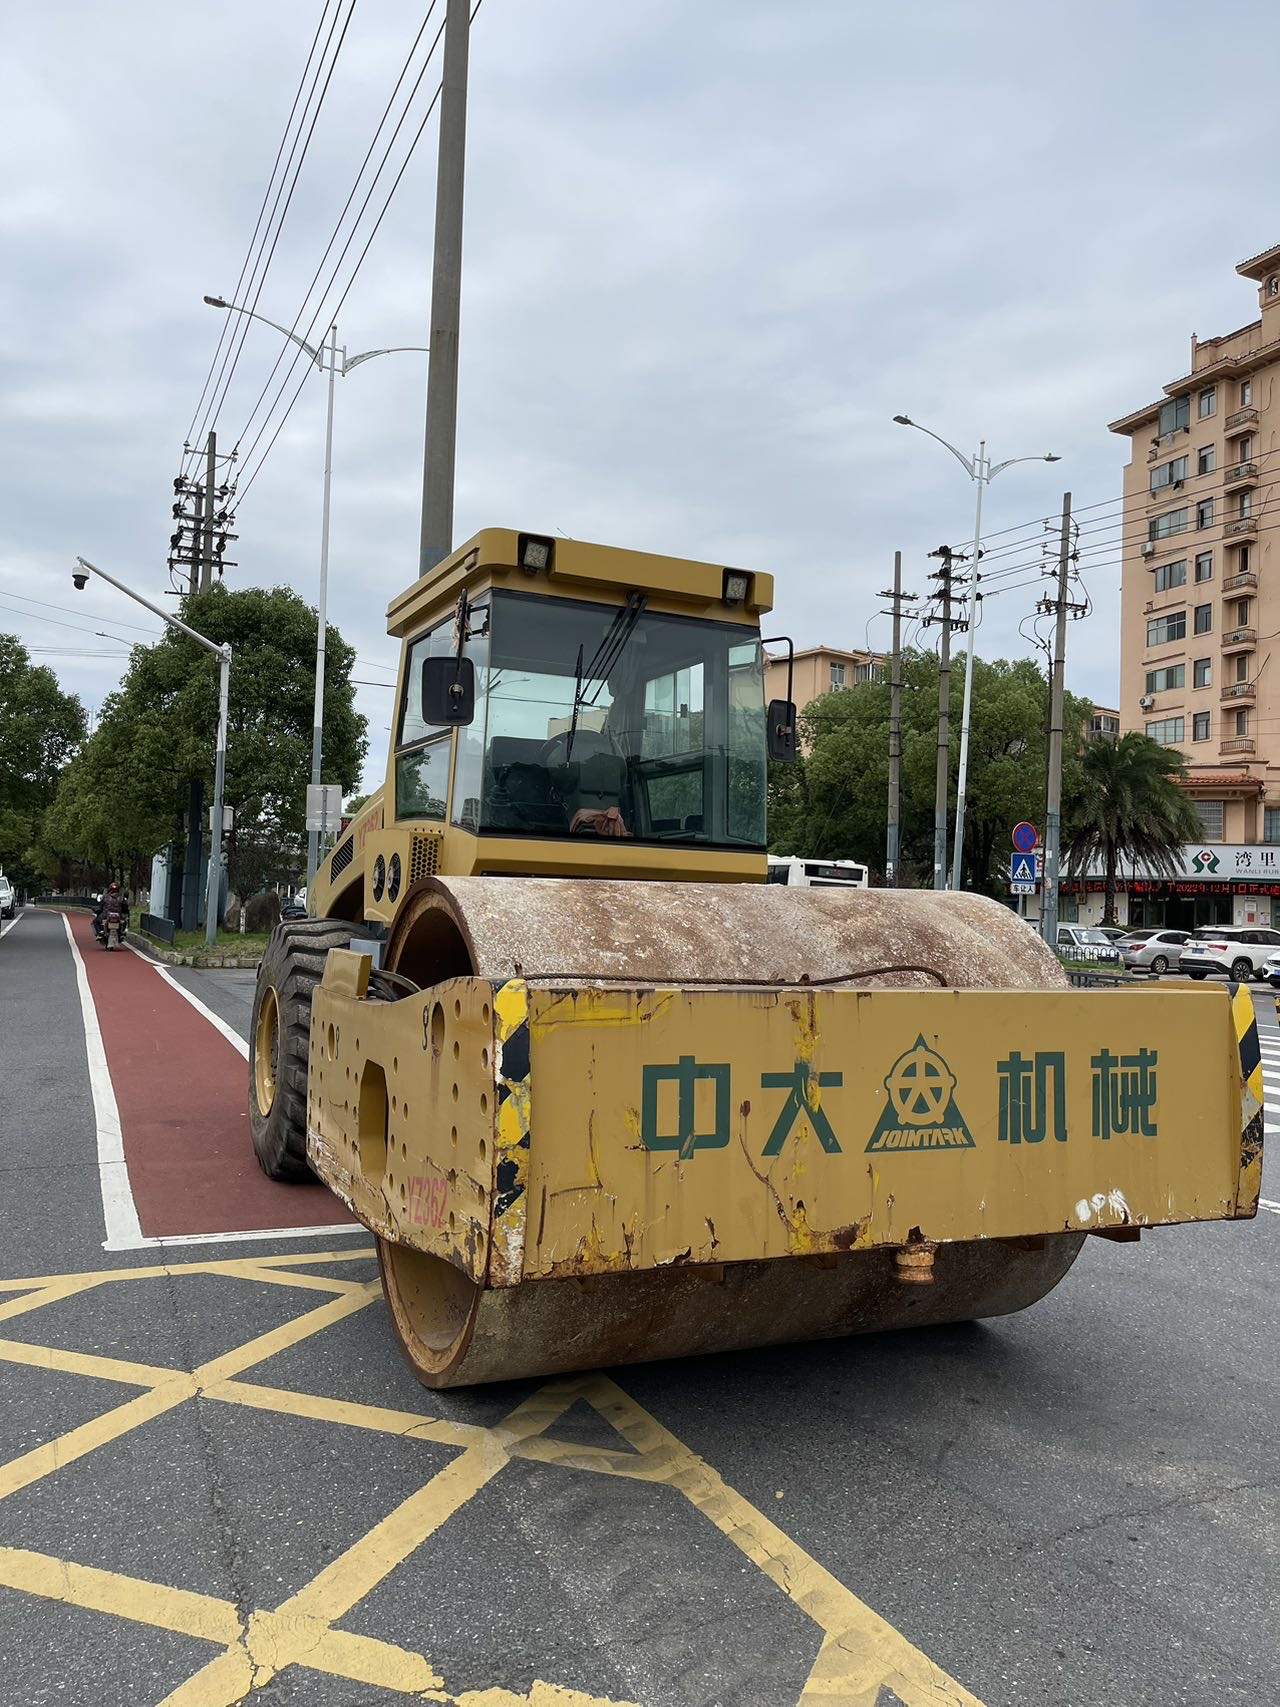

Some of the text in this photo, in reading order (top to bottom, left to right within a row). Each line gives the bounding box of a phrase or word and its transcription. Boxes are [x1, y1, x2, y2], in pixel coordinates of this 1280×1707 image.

[1235, 851, 1276, 867] 湾里
[1235, 867, 1261, 875] WANLI
[1013, 884, 1034, 893] 车让人
[642, 1047, 1158, 1160] 中大 机械
[871, 1127, 969, 1149] JOINTARK
